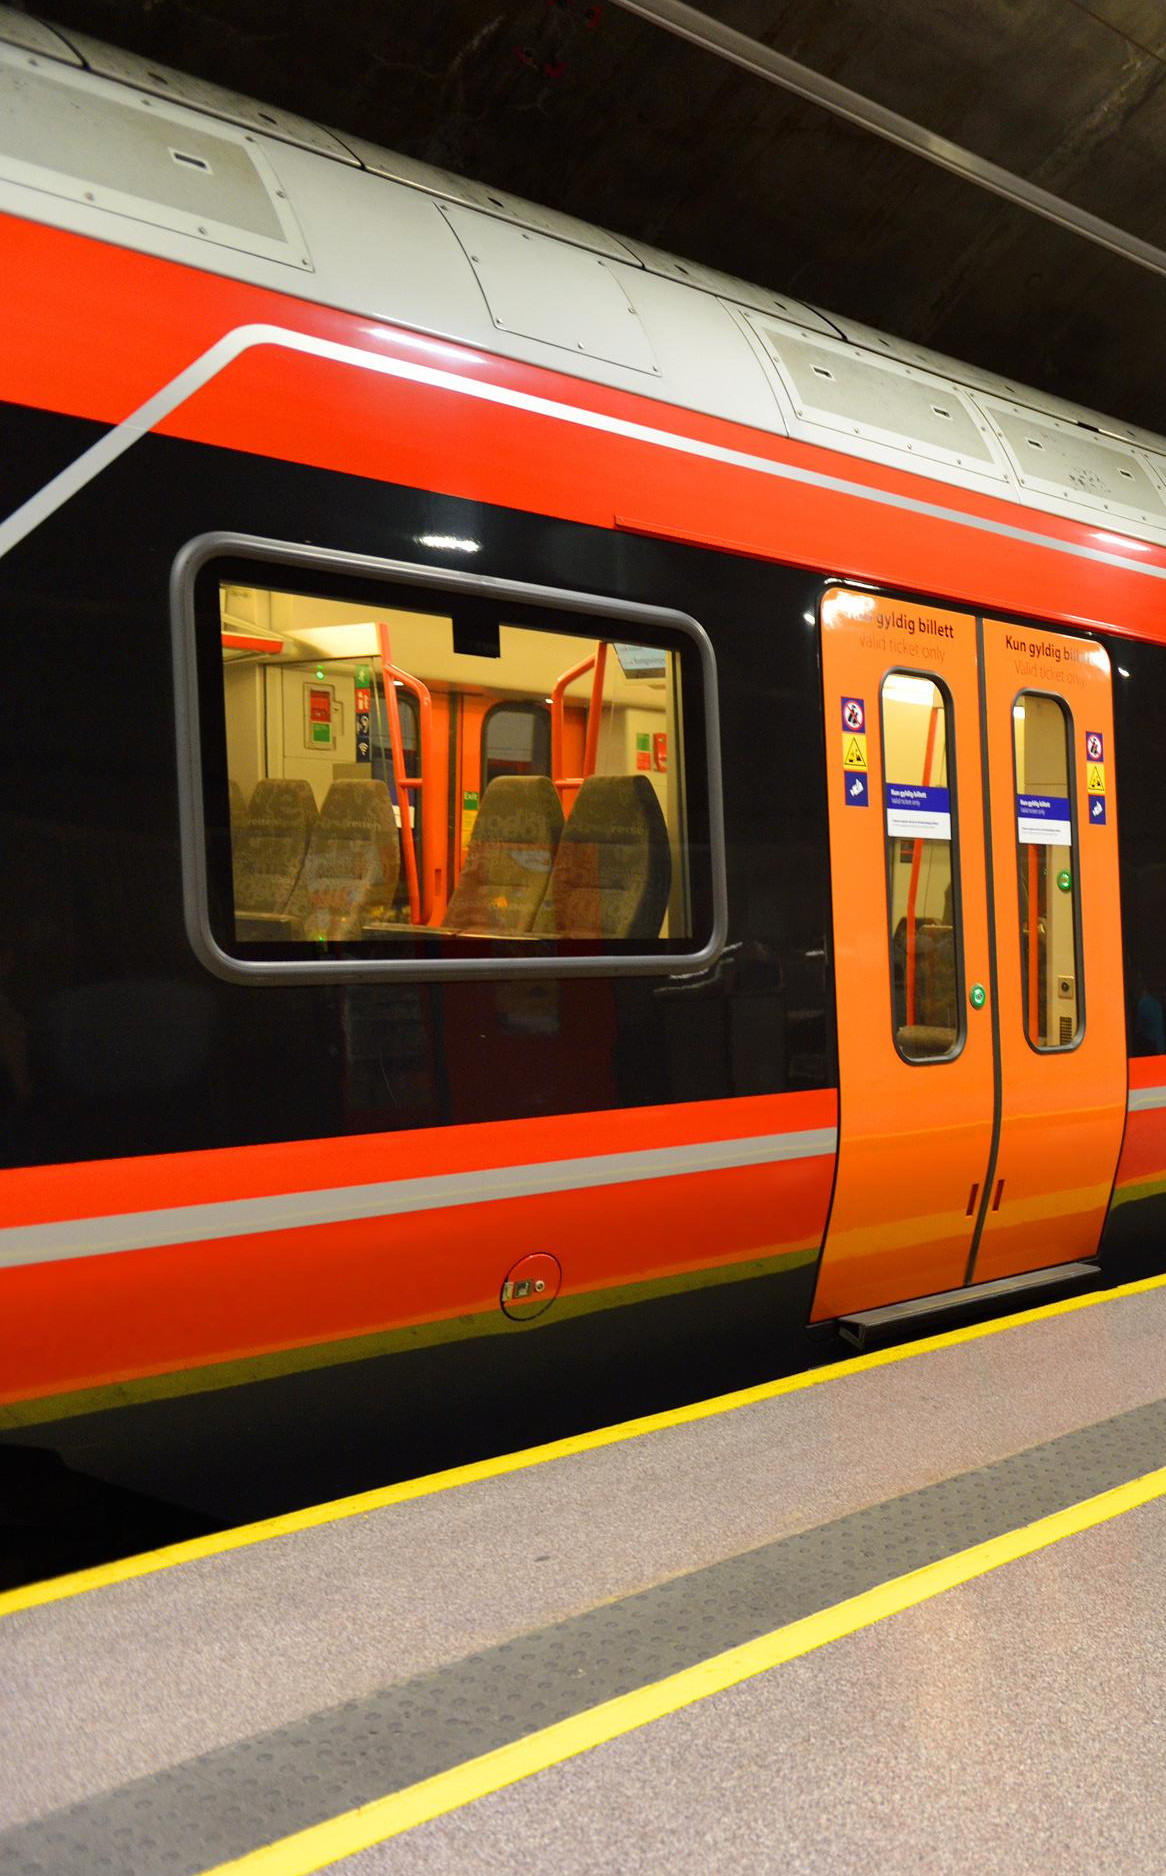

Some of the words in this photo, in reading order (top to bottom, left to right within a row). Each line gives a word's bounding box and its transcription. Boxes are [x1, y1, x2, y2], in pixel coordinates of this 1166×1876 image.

[876, 611, 915, 635] gyldig
[918, 618, 954, 639] billett
[1005, 635, 1027, 652] Kun
[1029, 642, 1061, 663] gyldig
